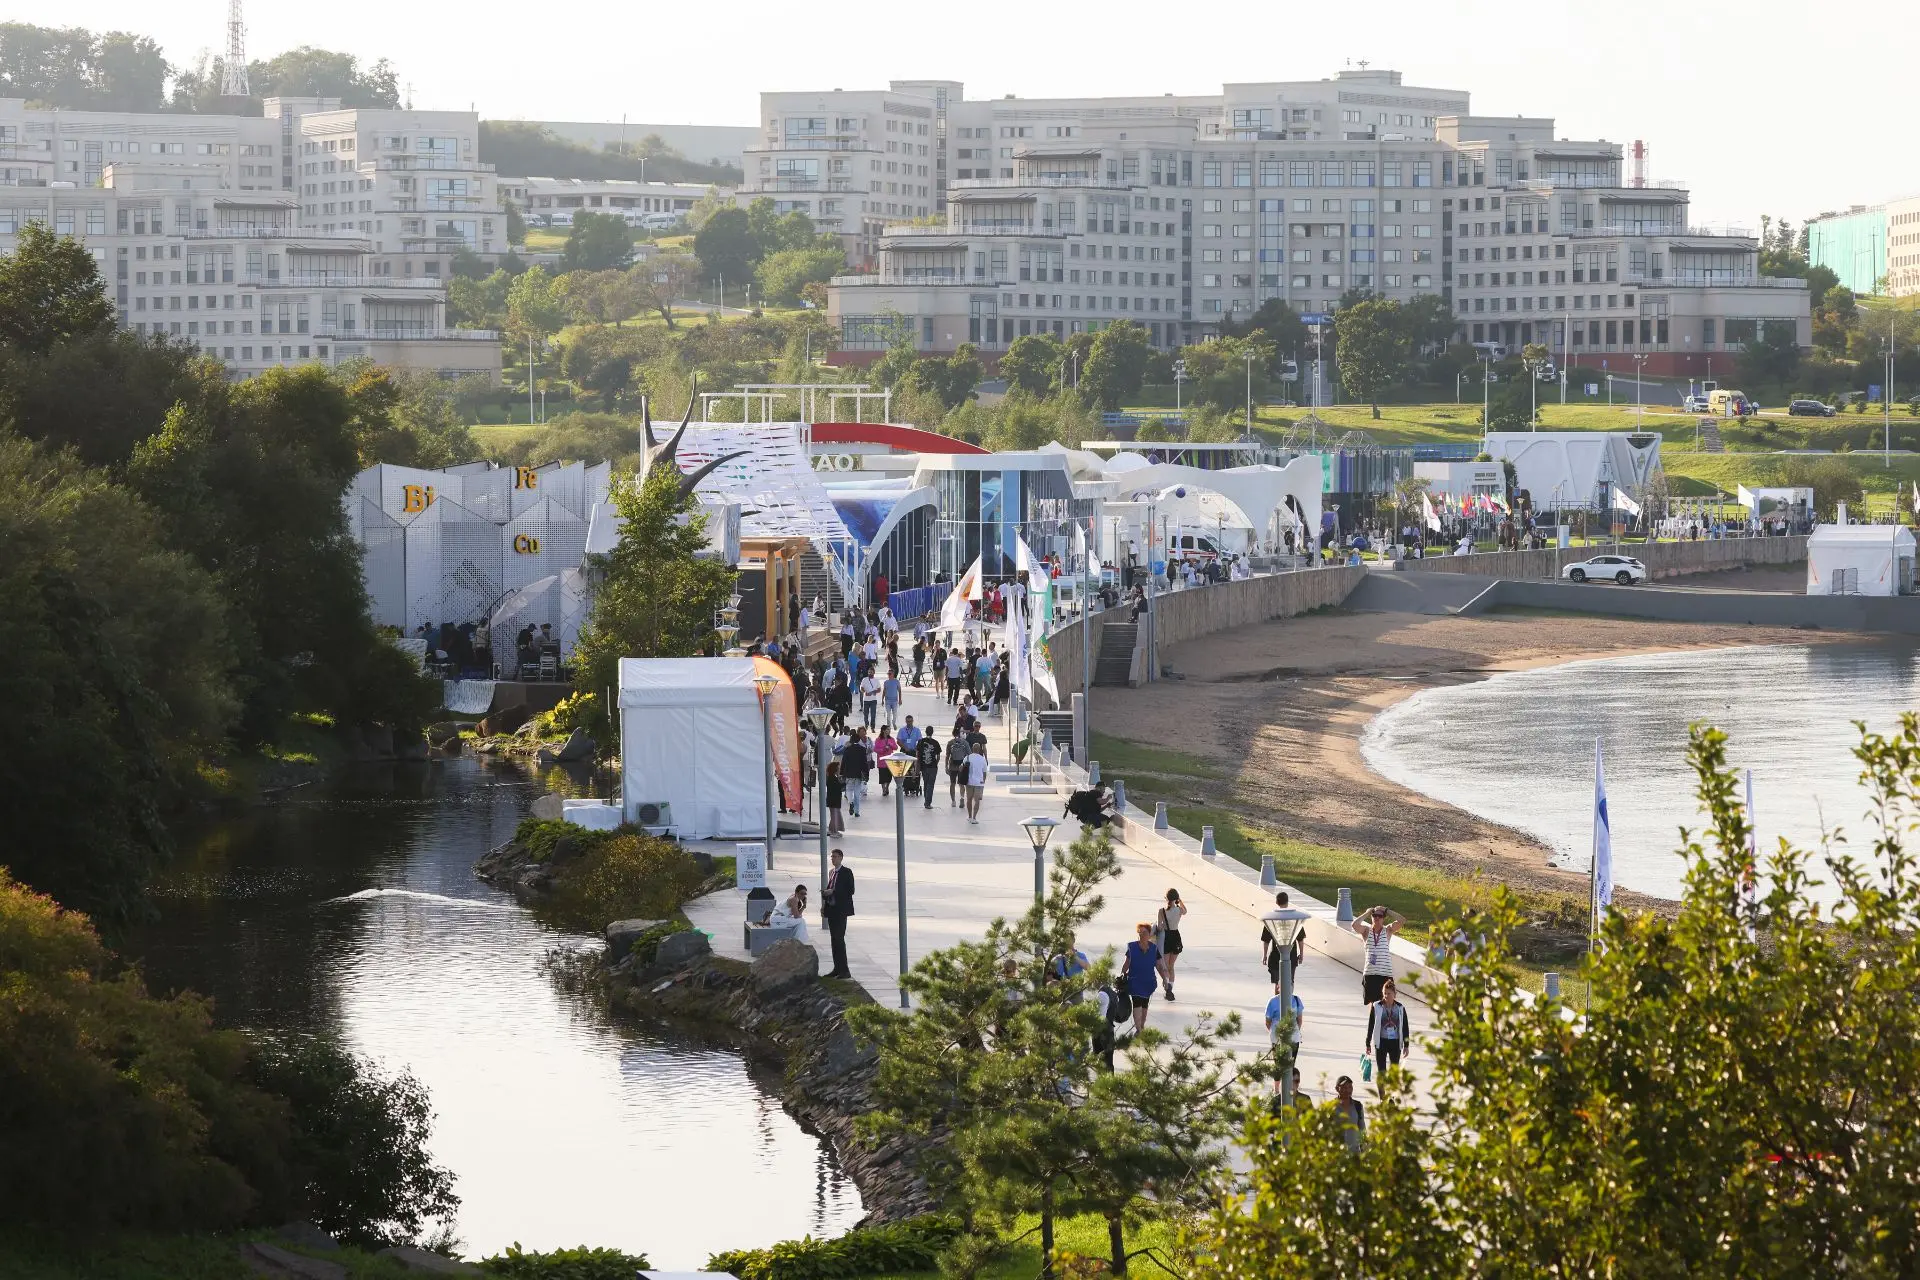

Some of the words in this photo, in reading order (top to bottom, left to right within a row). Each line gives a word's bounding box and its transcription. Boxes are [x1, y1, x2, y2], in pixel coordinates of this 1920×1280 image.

[811, 453, 854, 473] АО
[515, 466, 537, 490] Fe
[403, 485, 434, 513] Bi
[514, 533, 540, 554] Cu
